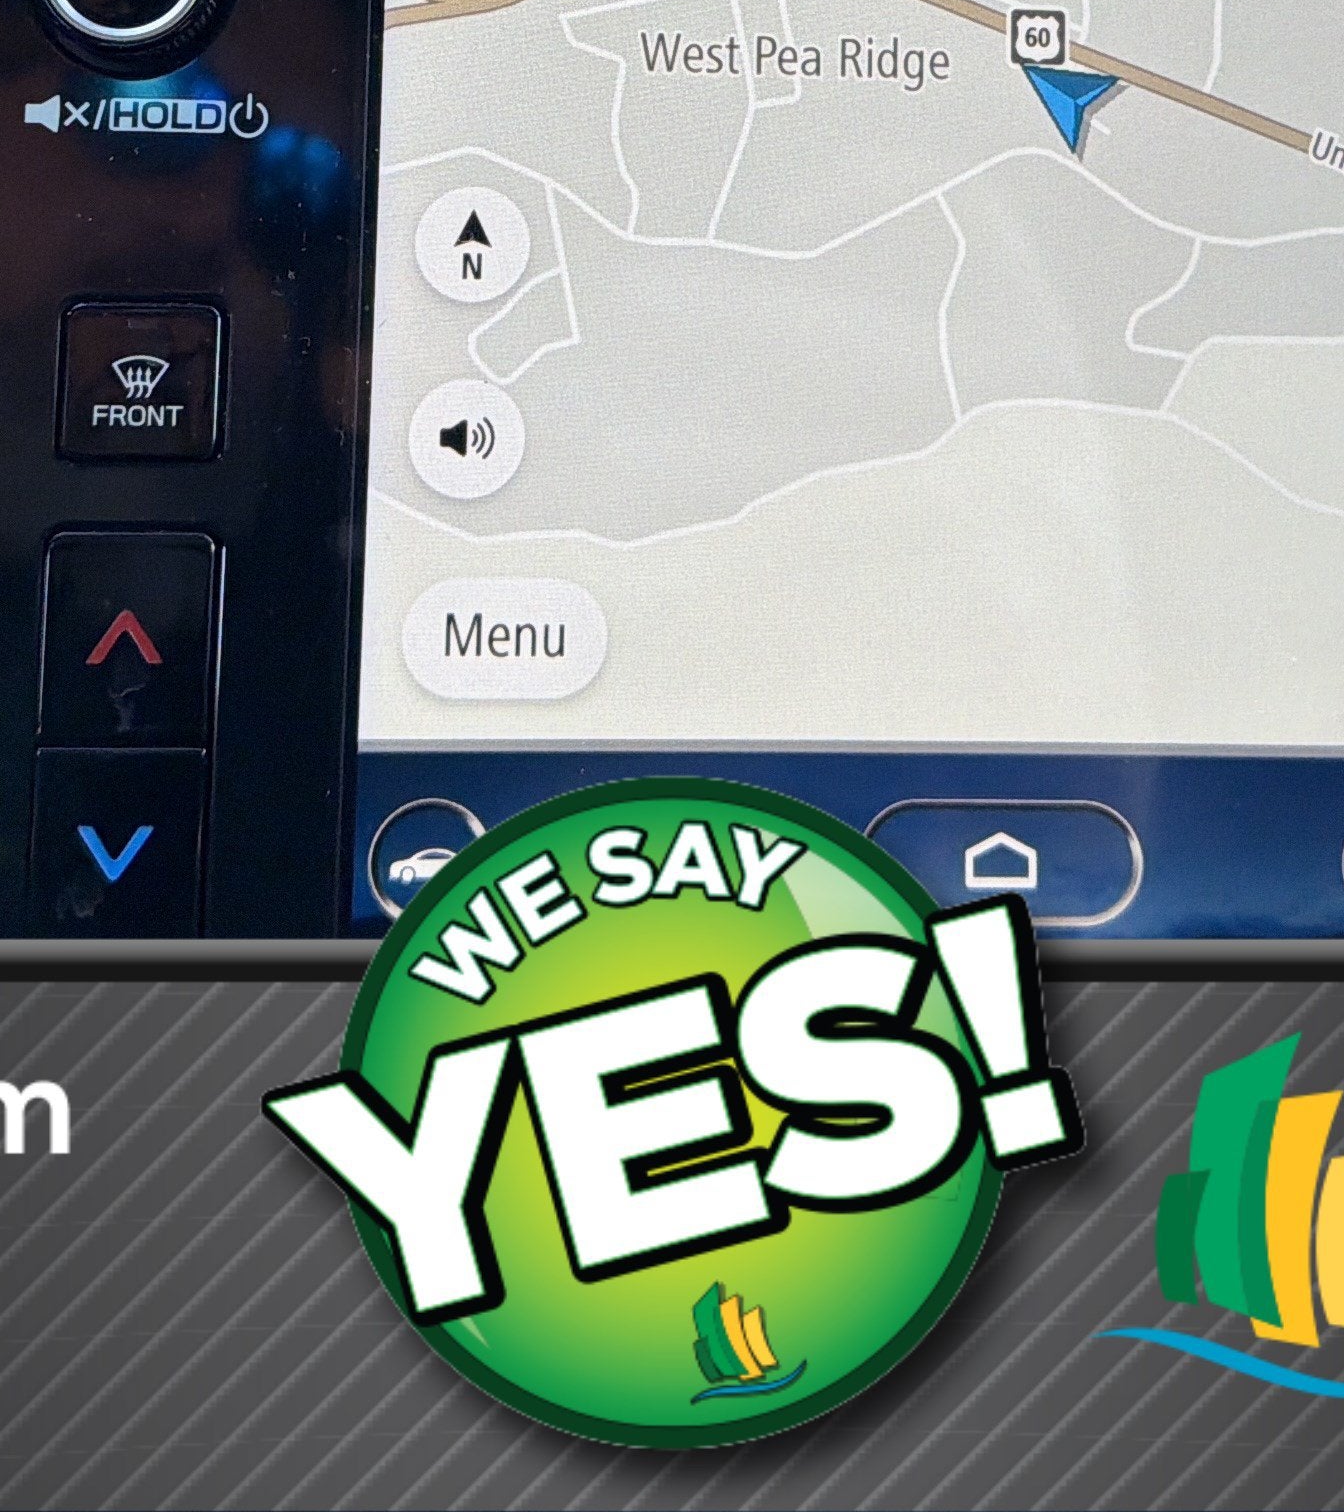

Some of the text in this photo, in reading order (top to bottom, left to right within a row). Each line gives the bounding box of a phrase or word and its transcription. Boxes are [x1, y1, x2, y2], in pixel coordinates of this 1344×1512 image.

[1024, 27, 1052, 49] 60
[640, 32, 951, 91] West Pea Ridge
[461, 254, 482, 280] N
[92, 405, 183, 427] FRONT
[443, 613, 566, 658] Menu
